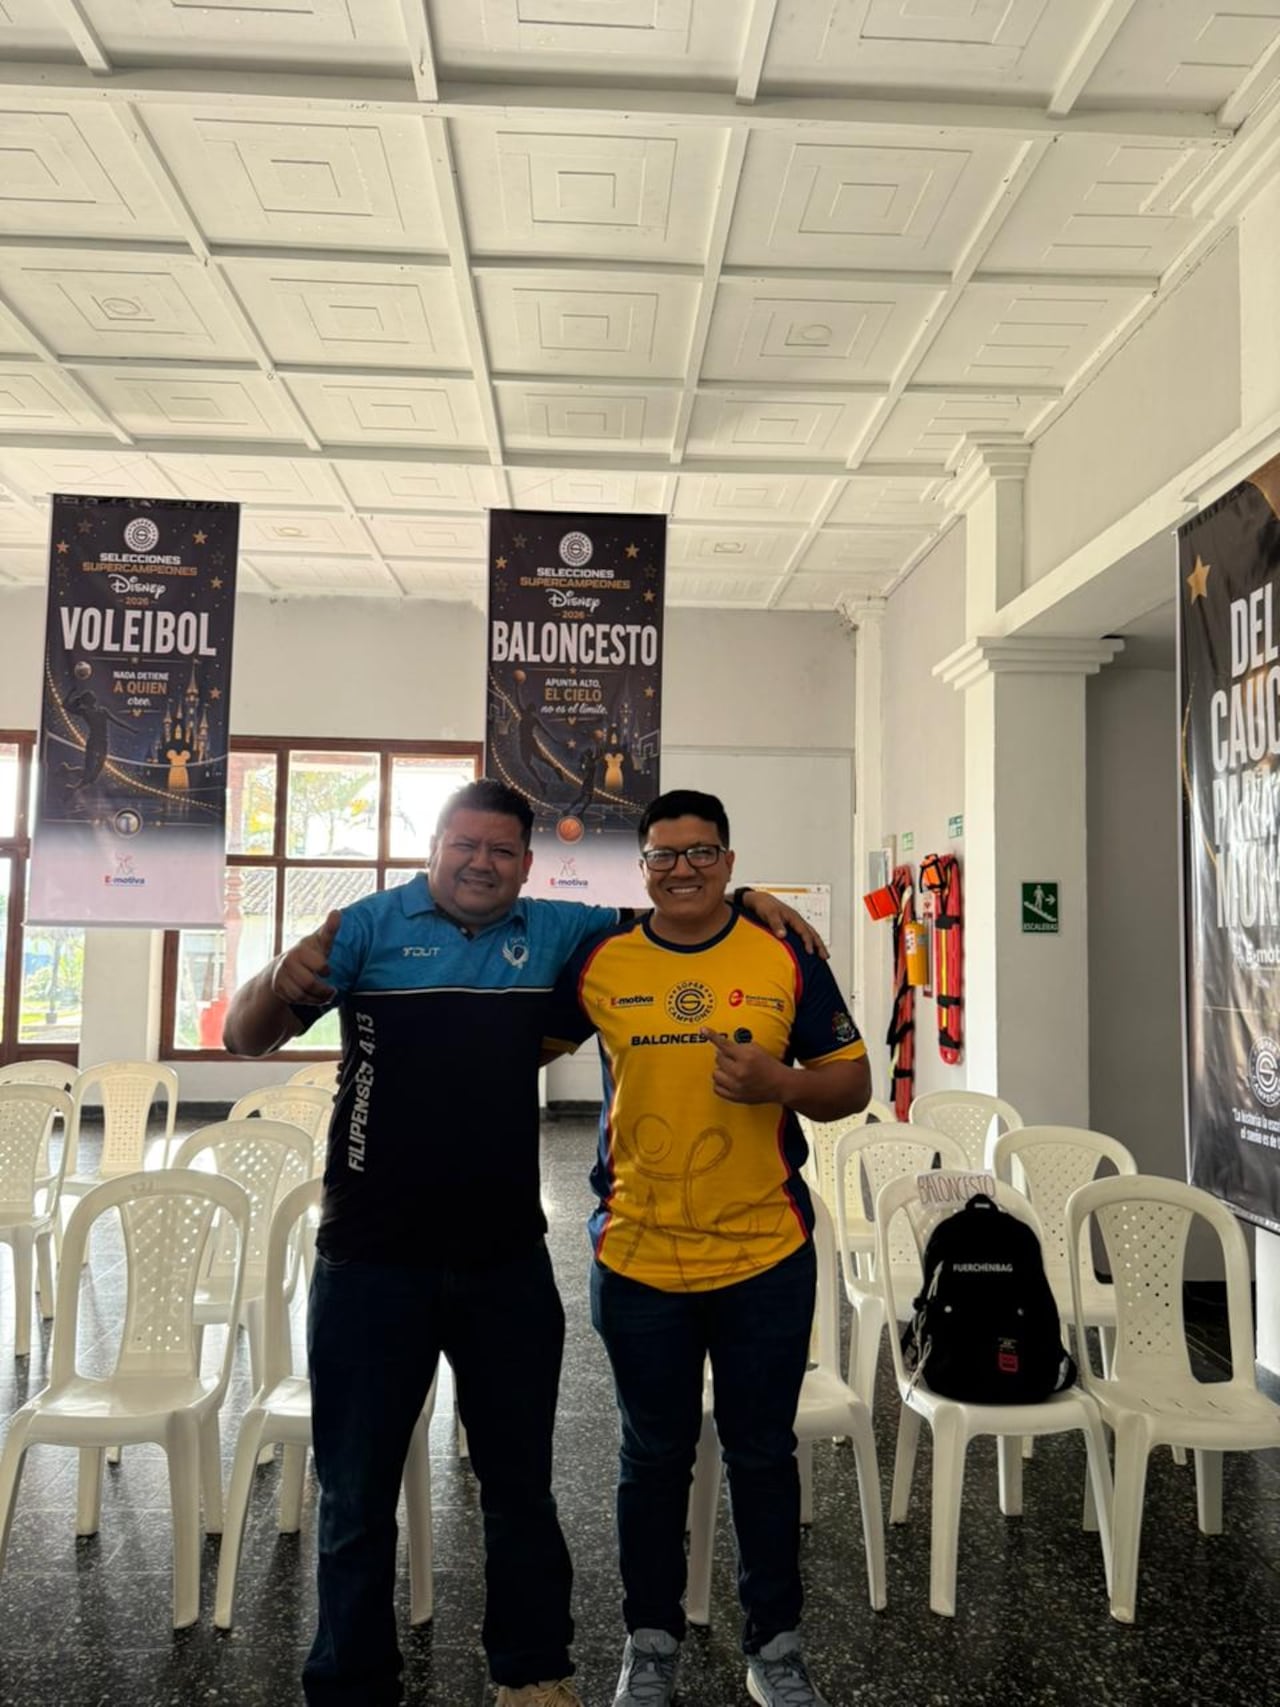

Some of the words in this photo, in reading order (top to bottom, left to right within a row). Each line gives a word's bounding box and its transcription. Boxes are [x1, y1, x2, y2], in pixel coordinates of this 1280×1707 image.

[99, 553, 181, 565] SELECCIONES
[82, 563, 198, 575] SUPERCAMPEONES
[537, 568, 614, 578] SELECCIONES
[108, 573, 167, 600] Disney
[520, 577, 630, 589] SUPERCAMPEONES
[545, 588, 600, 613] Disney
[60, 606, 216, 656] VOLEIBOL
[1230, 582, 1278, 678] DEL
[492, 621, 657, 666] BALONCESTO
[113, 671, 136, 680] NADA
[137, 671, 169, 681] DETIENE
[545, 678, 578, 688] APUNTA
[113, 681, 124, 694] A
[127, 681, 168, 695] QUIEN
[544, 688, 561, 702] EL
[563, 689, 603, 702] CIELO
[540, 705, 554, 714] no
[567, 702, 580, 714] el
[356, 1012, 376, 1056] 4:13
[631, 1032, 728, 1046] BALONCES
